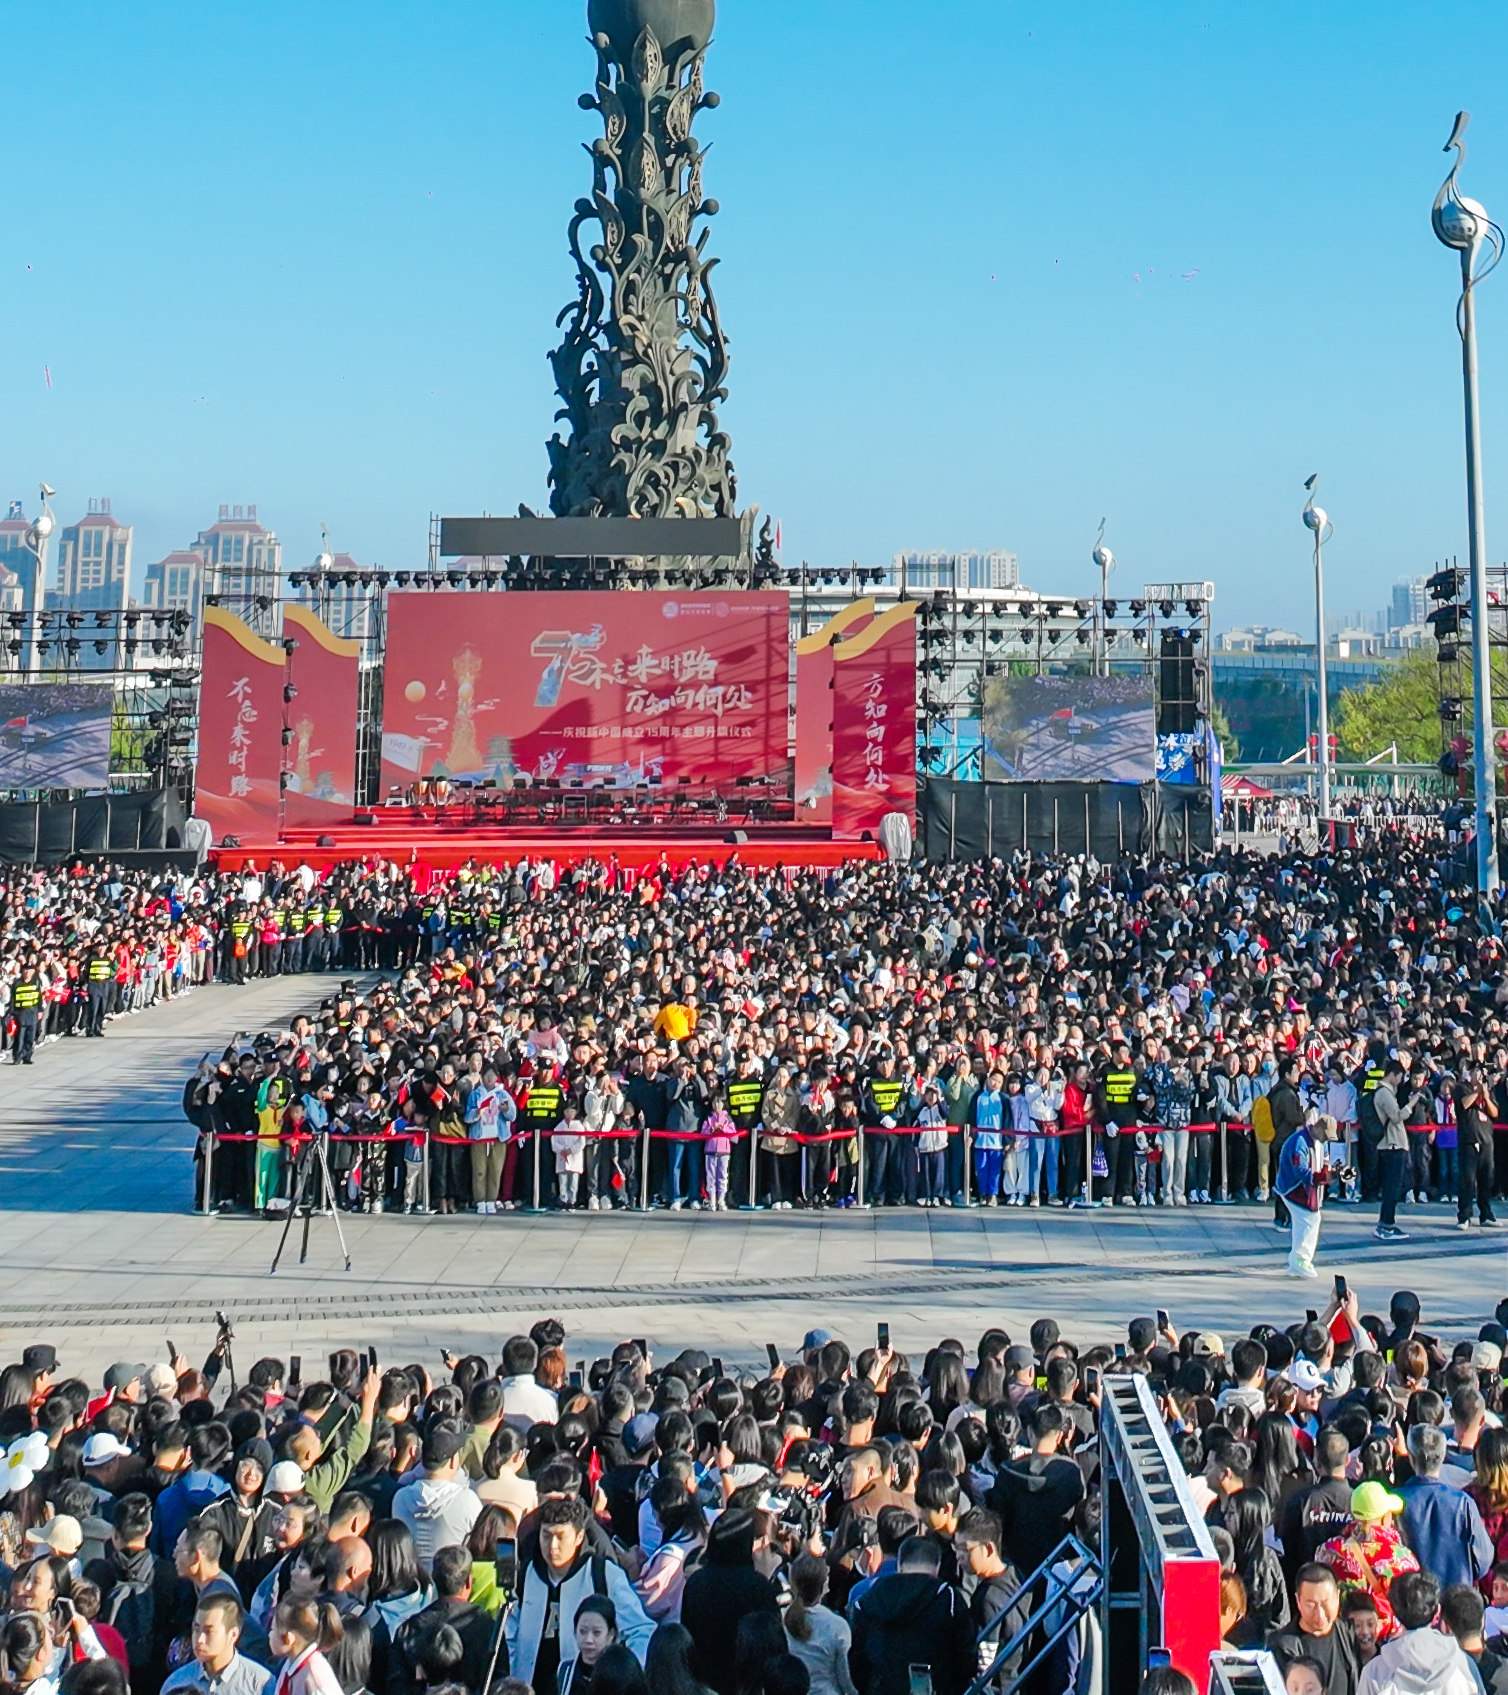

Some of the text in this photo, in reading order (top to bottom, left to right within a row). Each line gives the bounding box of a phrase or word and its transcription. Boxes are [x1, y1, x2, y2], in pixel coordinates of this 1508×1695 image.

[590, 644, 719, 690] 不忘来时路
[625, 684, 753, 717] 方知向何处
[227, 677, 258, 797] 不忘来时路
[862, 673, 890, 791] 方知向何处
